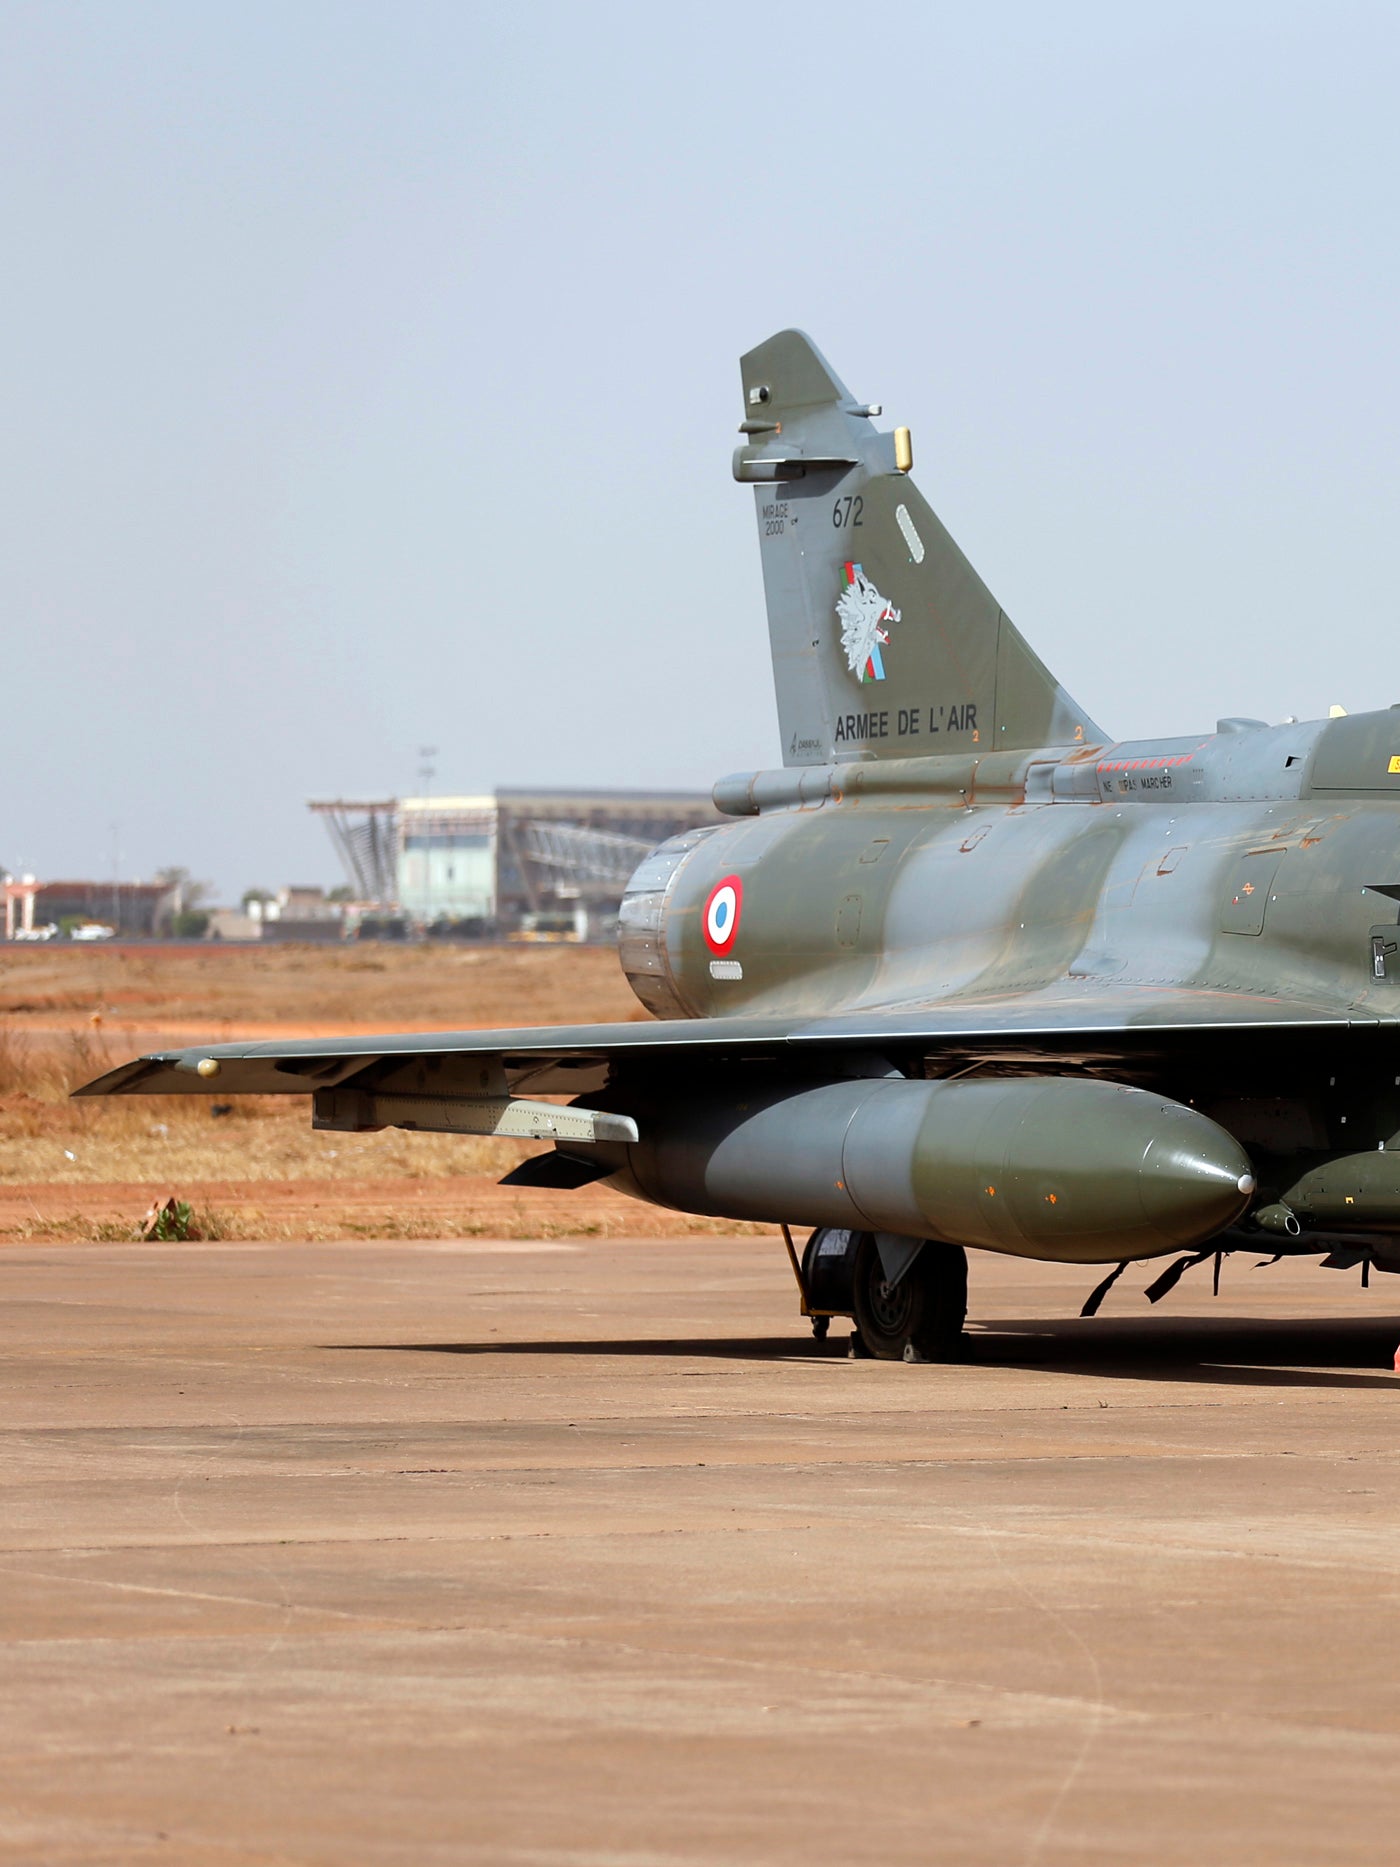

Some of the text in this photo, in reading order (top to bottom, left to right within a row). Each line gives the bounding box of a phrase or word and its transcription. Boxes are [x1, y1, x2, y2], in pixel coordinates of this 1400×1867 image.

[762, 503, 788, 519] MIRAGE
[833, 496, 864, 528] 672
[766, 520, 784, 536] 2000
[835, 711, 889, 742] ARMEE
[898, 708, 920, 736] DE
[1103, 781, 1112, 792] NE
[1141, 776, 1172, 789] MARCHER
